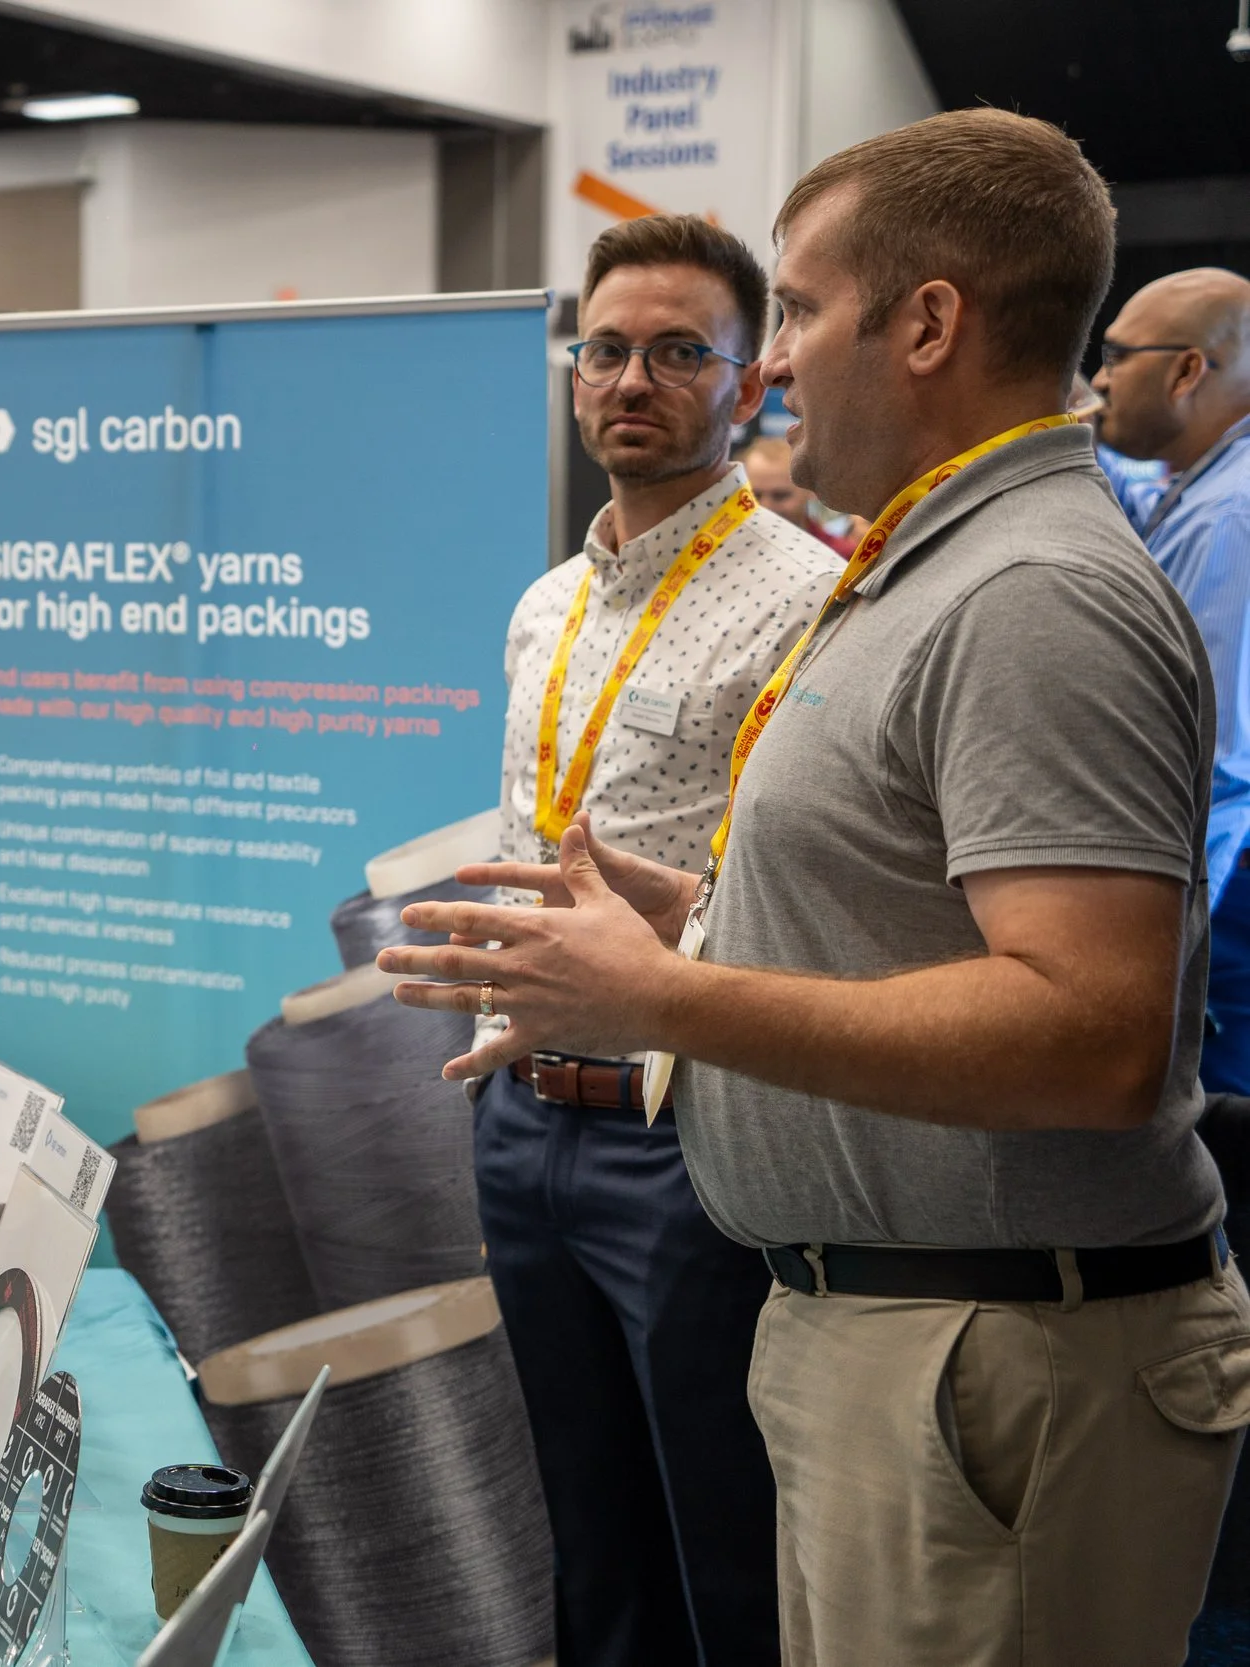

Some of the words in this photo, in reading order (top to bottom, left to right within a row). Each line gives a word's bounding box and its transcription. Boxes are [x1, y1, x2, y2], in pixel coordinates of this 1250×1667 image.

[609, 64, 719, 99] Industry
[626, 102, 698, 135] Panel
[33, 407, 89, 462] sgl
[99, 406, 241, 453] carbon
[691, 539, 711, 560] 3S
[858, 538, 882, 564] 3S
[197, 552, 303, 592] yarns
[37, 593, 111, 641] high
[121, 595, 187, 634] end
[198, 597, 370, 648] packings
[650, 599, 667, 619] 3S
[21, 670, 70, 691] users
[75, 669, 139, 693] benefit
[143, 672, 188, 696] from
[193, 675, 244, 702] using
[249, 679, 379, 705] compression
[383, 684, 479, 711] packings
[38, 699, 77, 718] with
[80, 702, 109, 719] our
[114, 700, 154, 726] high
[158, 704, 224, 730] quality
[228, 707, 265, 728] and
[270, 707, 312, 735] high
[318, 713, 377, 737] purity
[383, 716, 440, 738] yarns
[540, 741, 551, 762] 3S
[584, 728, 598, 749] 3S
[736, 725, 753, 760] SERVICES
[741, 727, 759, 758] SEALING
[116, 763, 181, 786] portfolio
[184, 765, 203, 786] of
[233, 769, 264, 790] and
[268, 772, 321, 794] textile
[60, 789, 101, 808] yarns
[104, 790, 148, 811] made
[152, 792, 189, 812] from
[193, 795, 262, 819] different
[266, 801, 357, 826] precursors
[558, 795, 574, 817] 3S
[30, 849, 64, 870] heat
[67, 851, 150, 876] dissipation
[52, 824, 148, 849] combination
[150, 831, 167, 850] of
[169, 833, 232, 857] superior
[236, 838, 322, 867] sealability
[0, 911, 27, 931] and
[30, 915, 97, 938] chemical
[69, 890, 103, 914] high
[105, 893, 202, 921] temperature
[206, 901, 291, 929] resistance
[67, 955, 127, 980] process
[130, 962, 243, 991] contamination
[0, 975, 27, 996] due
[30, 979, 44, 997] to
[50, 979, 82, 1005] high
[85, 985, 131, 1010] purity
